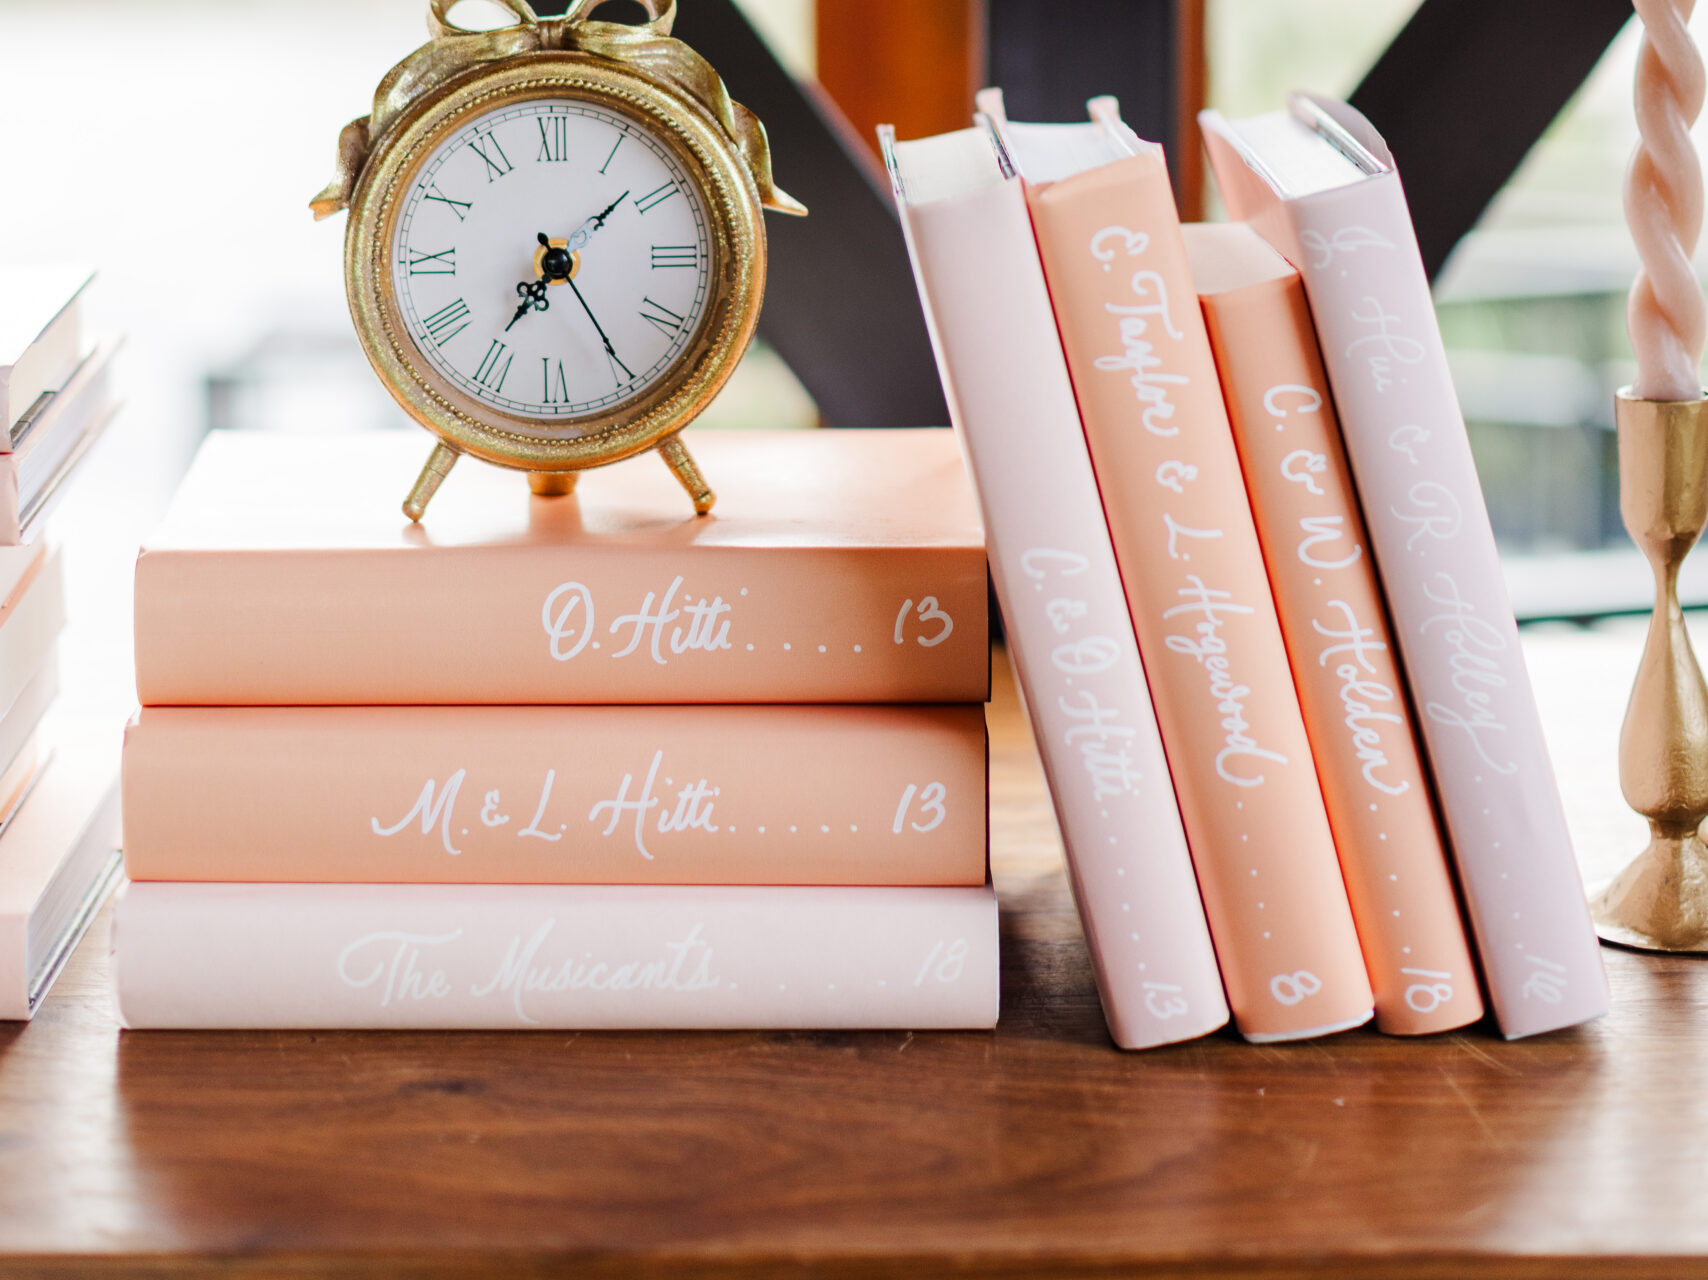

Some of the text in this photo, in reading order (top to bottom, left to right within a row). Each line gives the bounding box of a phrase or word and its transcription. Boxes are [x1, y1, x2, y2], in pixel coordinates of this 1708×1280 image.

[467, 131, 515, 183] XI
[536, 116, 568, 162] XII
[424, 183, 472, 221] X
[409, 246, 456, 276] IX
[892, 596, 954, 648] 13
[1093, 269, 1190, 437] Taylor
[1269, 970, 1321, 1006] 8
[1422, 572, 1519, 775] Holley
[892, 781, 947, 833] 13
[1312, 599, 1409, 795] Holden
[1401, 967, 1453, 1013] 18
[337, 927, 463, 1006] The
[914, 938, 969, 988] 18
[1142, 980, 1188, 1020] 13
